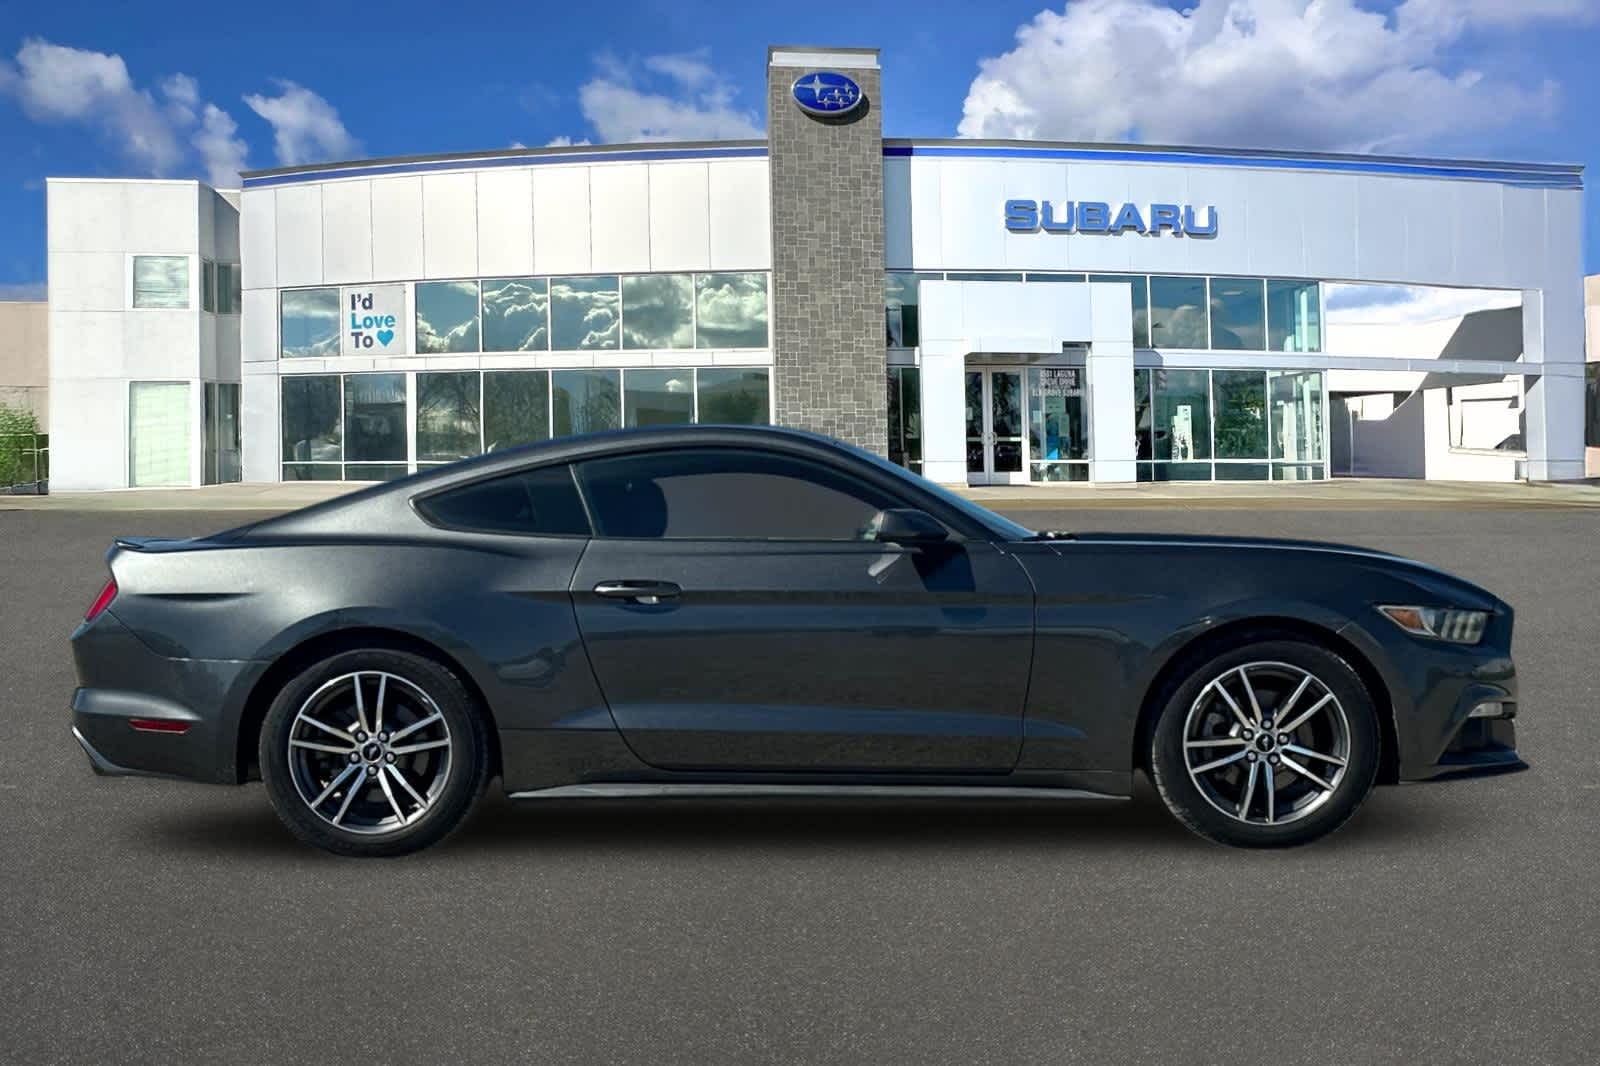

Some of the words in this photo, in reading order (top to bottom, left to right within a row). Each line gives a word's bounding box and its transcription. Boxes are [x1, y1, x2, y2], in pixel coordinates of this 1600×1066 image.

[1005, 199, 1218, 238] SUBARU
[351, 293, 373, 310] I'd
[351, 313, 396, 329] Love
[351, 331, 374, 348] To
